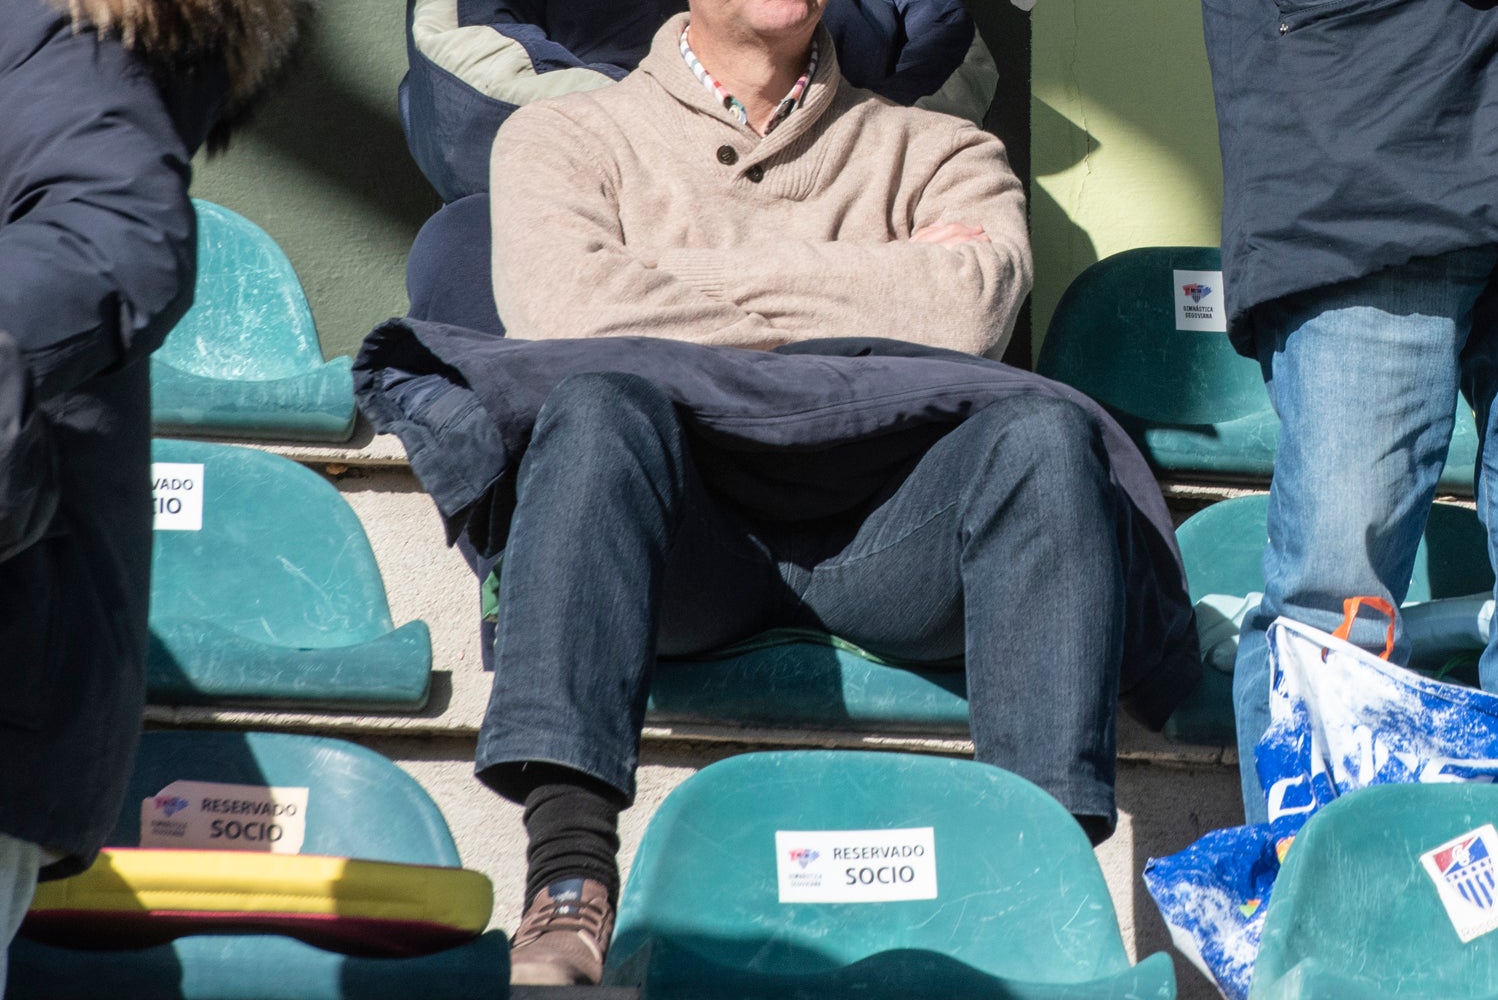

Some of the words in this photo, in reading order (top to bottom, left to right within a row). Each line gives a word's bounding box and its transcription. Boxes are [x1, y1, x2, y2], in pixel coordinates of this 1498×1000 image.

[200, 796, 297, 817] RESERVADO
[209, 819, 284, 842] SOCIO
[833, 844, 925, 861] RESERVADO
[844, 864, 915, 886] SOCIO
